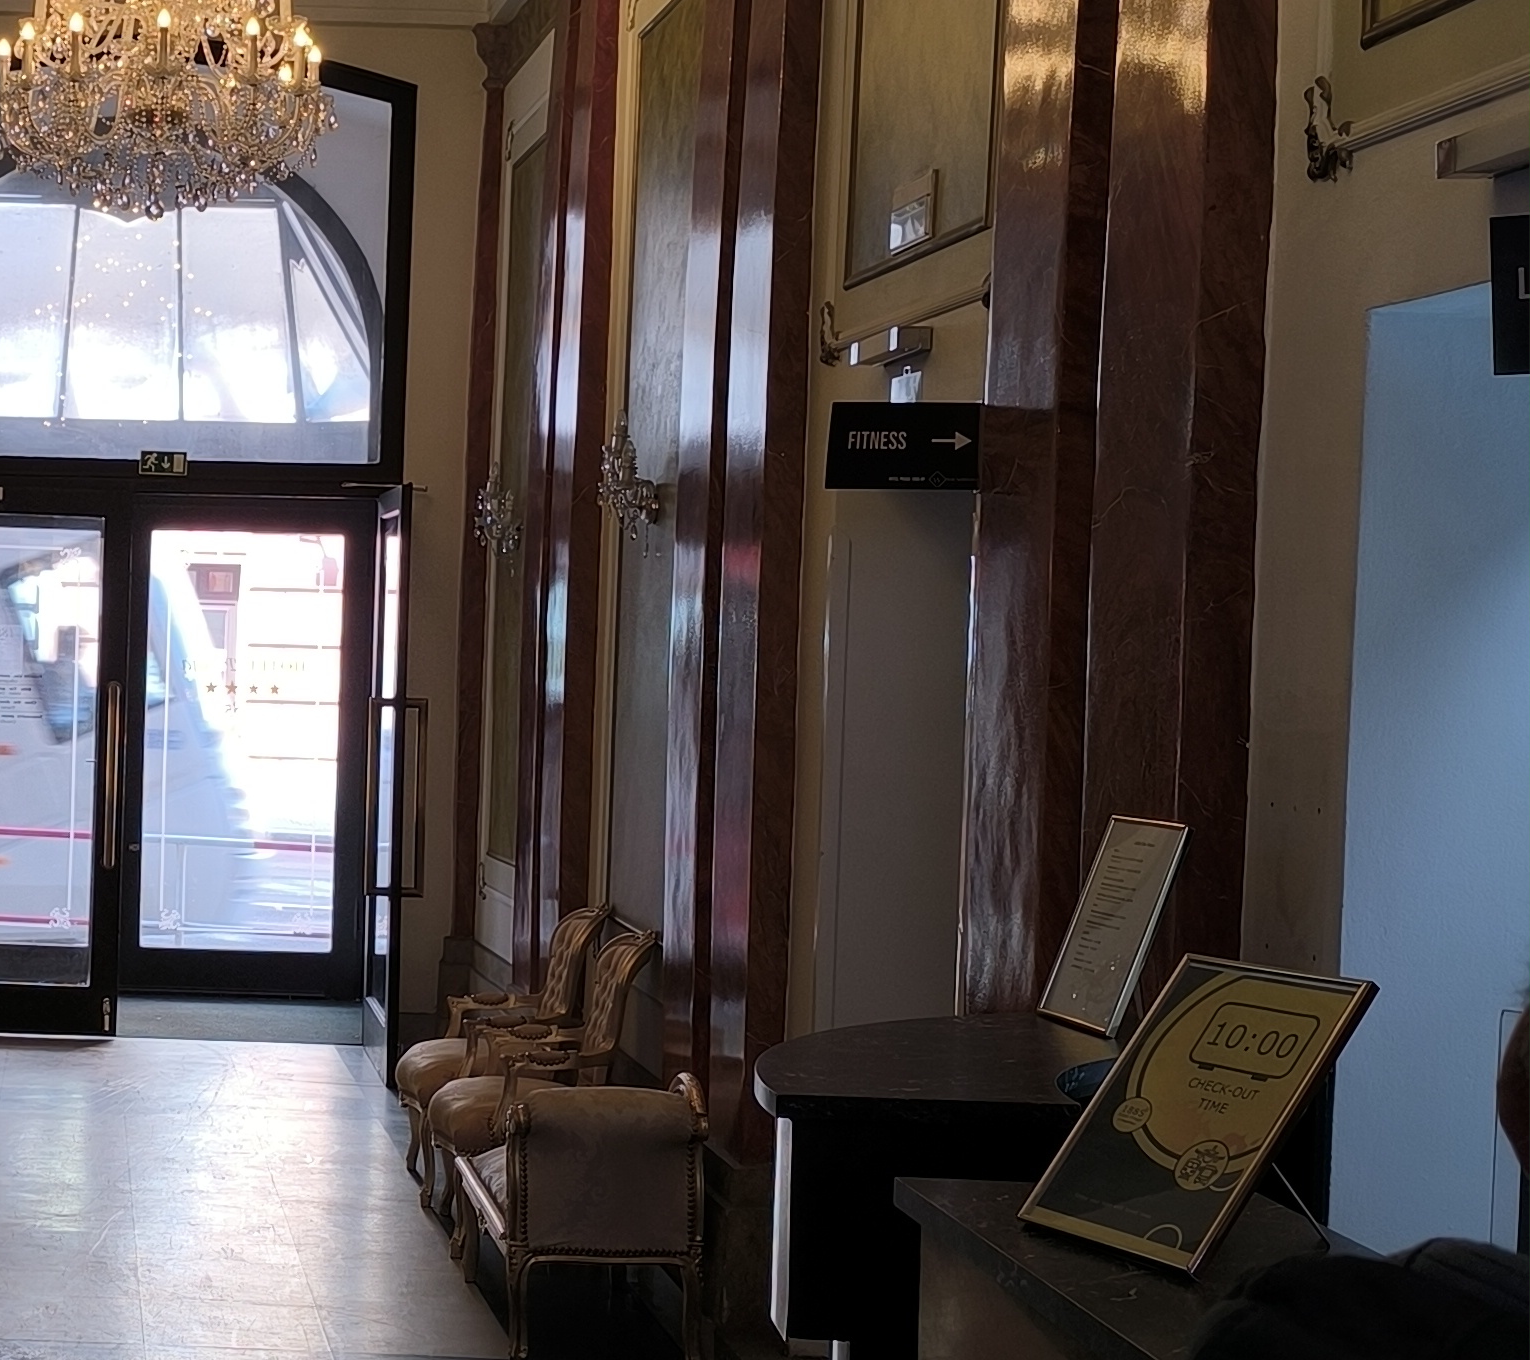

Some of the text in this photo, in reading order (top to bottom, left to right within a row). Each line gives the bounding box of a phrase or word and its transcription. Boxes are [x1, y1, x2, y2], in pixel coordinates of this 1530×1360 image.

[847, 431, 907, 450] FITNESS
[1206, 1022, 1299, 1058] 10:00
[1188, 1077, 1260, 1100] CHECK-OUT
[1198, 1097, 1229, 1115] TIME
